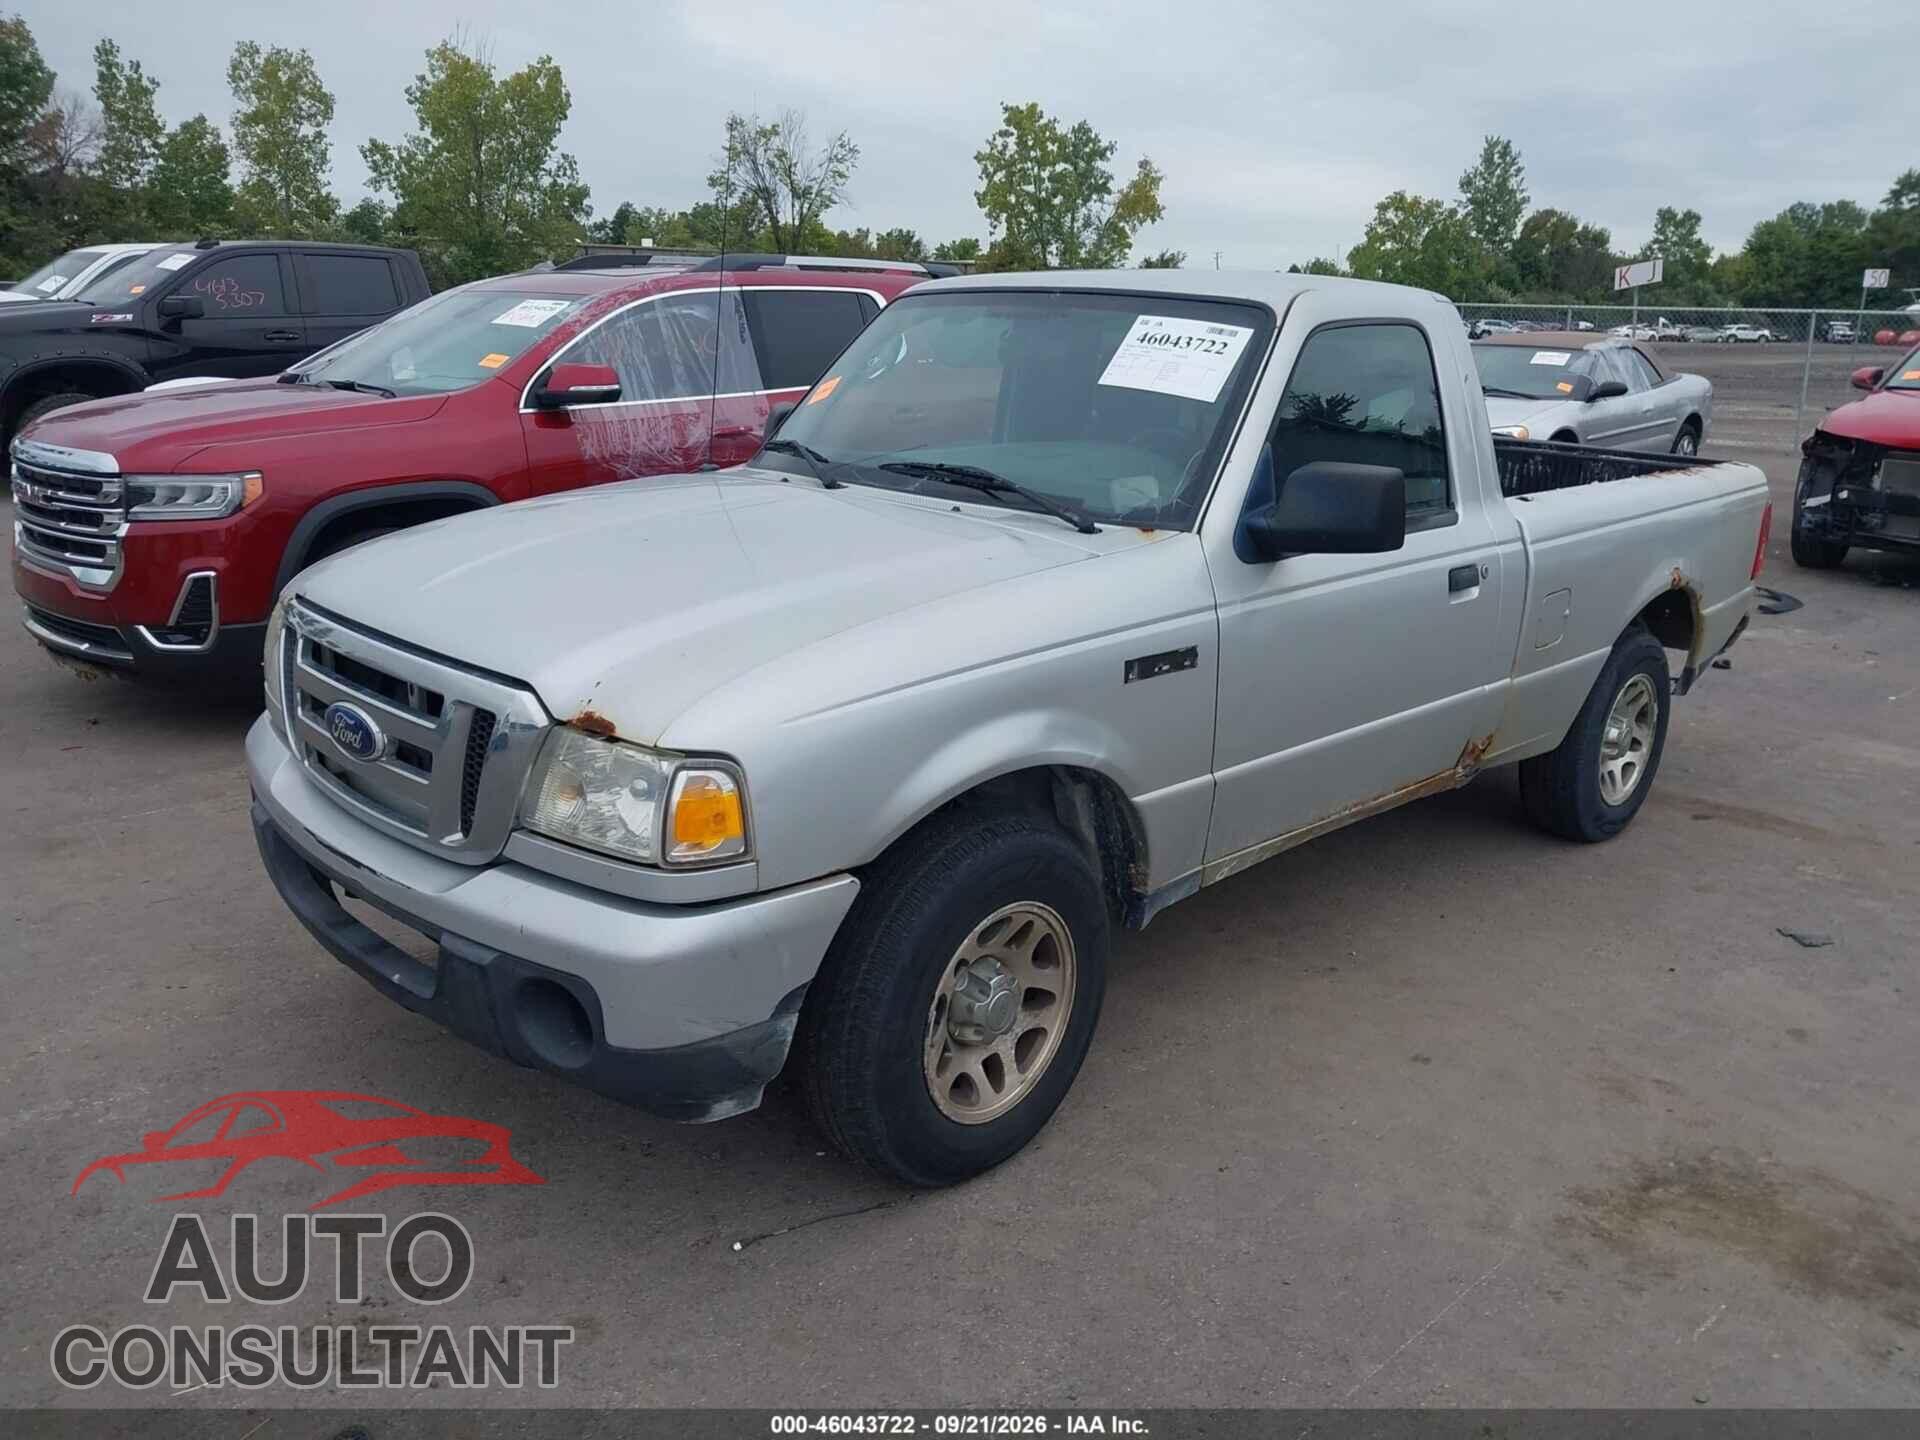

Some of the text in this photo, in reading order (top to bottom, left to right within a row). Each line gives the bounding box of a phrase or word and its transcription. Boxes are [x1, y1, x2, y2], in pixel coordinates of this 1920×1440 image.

[1619, 264, 1631, 288] K
[1648, 261, 1656, 281] J
[1136, 331, 1229, 355] 46043722
[332, 711, 362, 749] Ford
